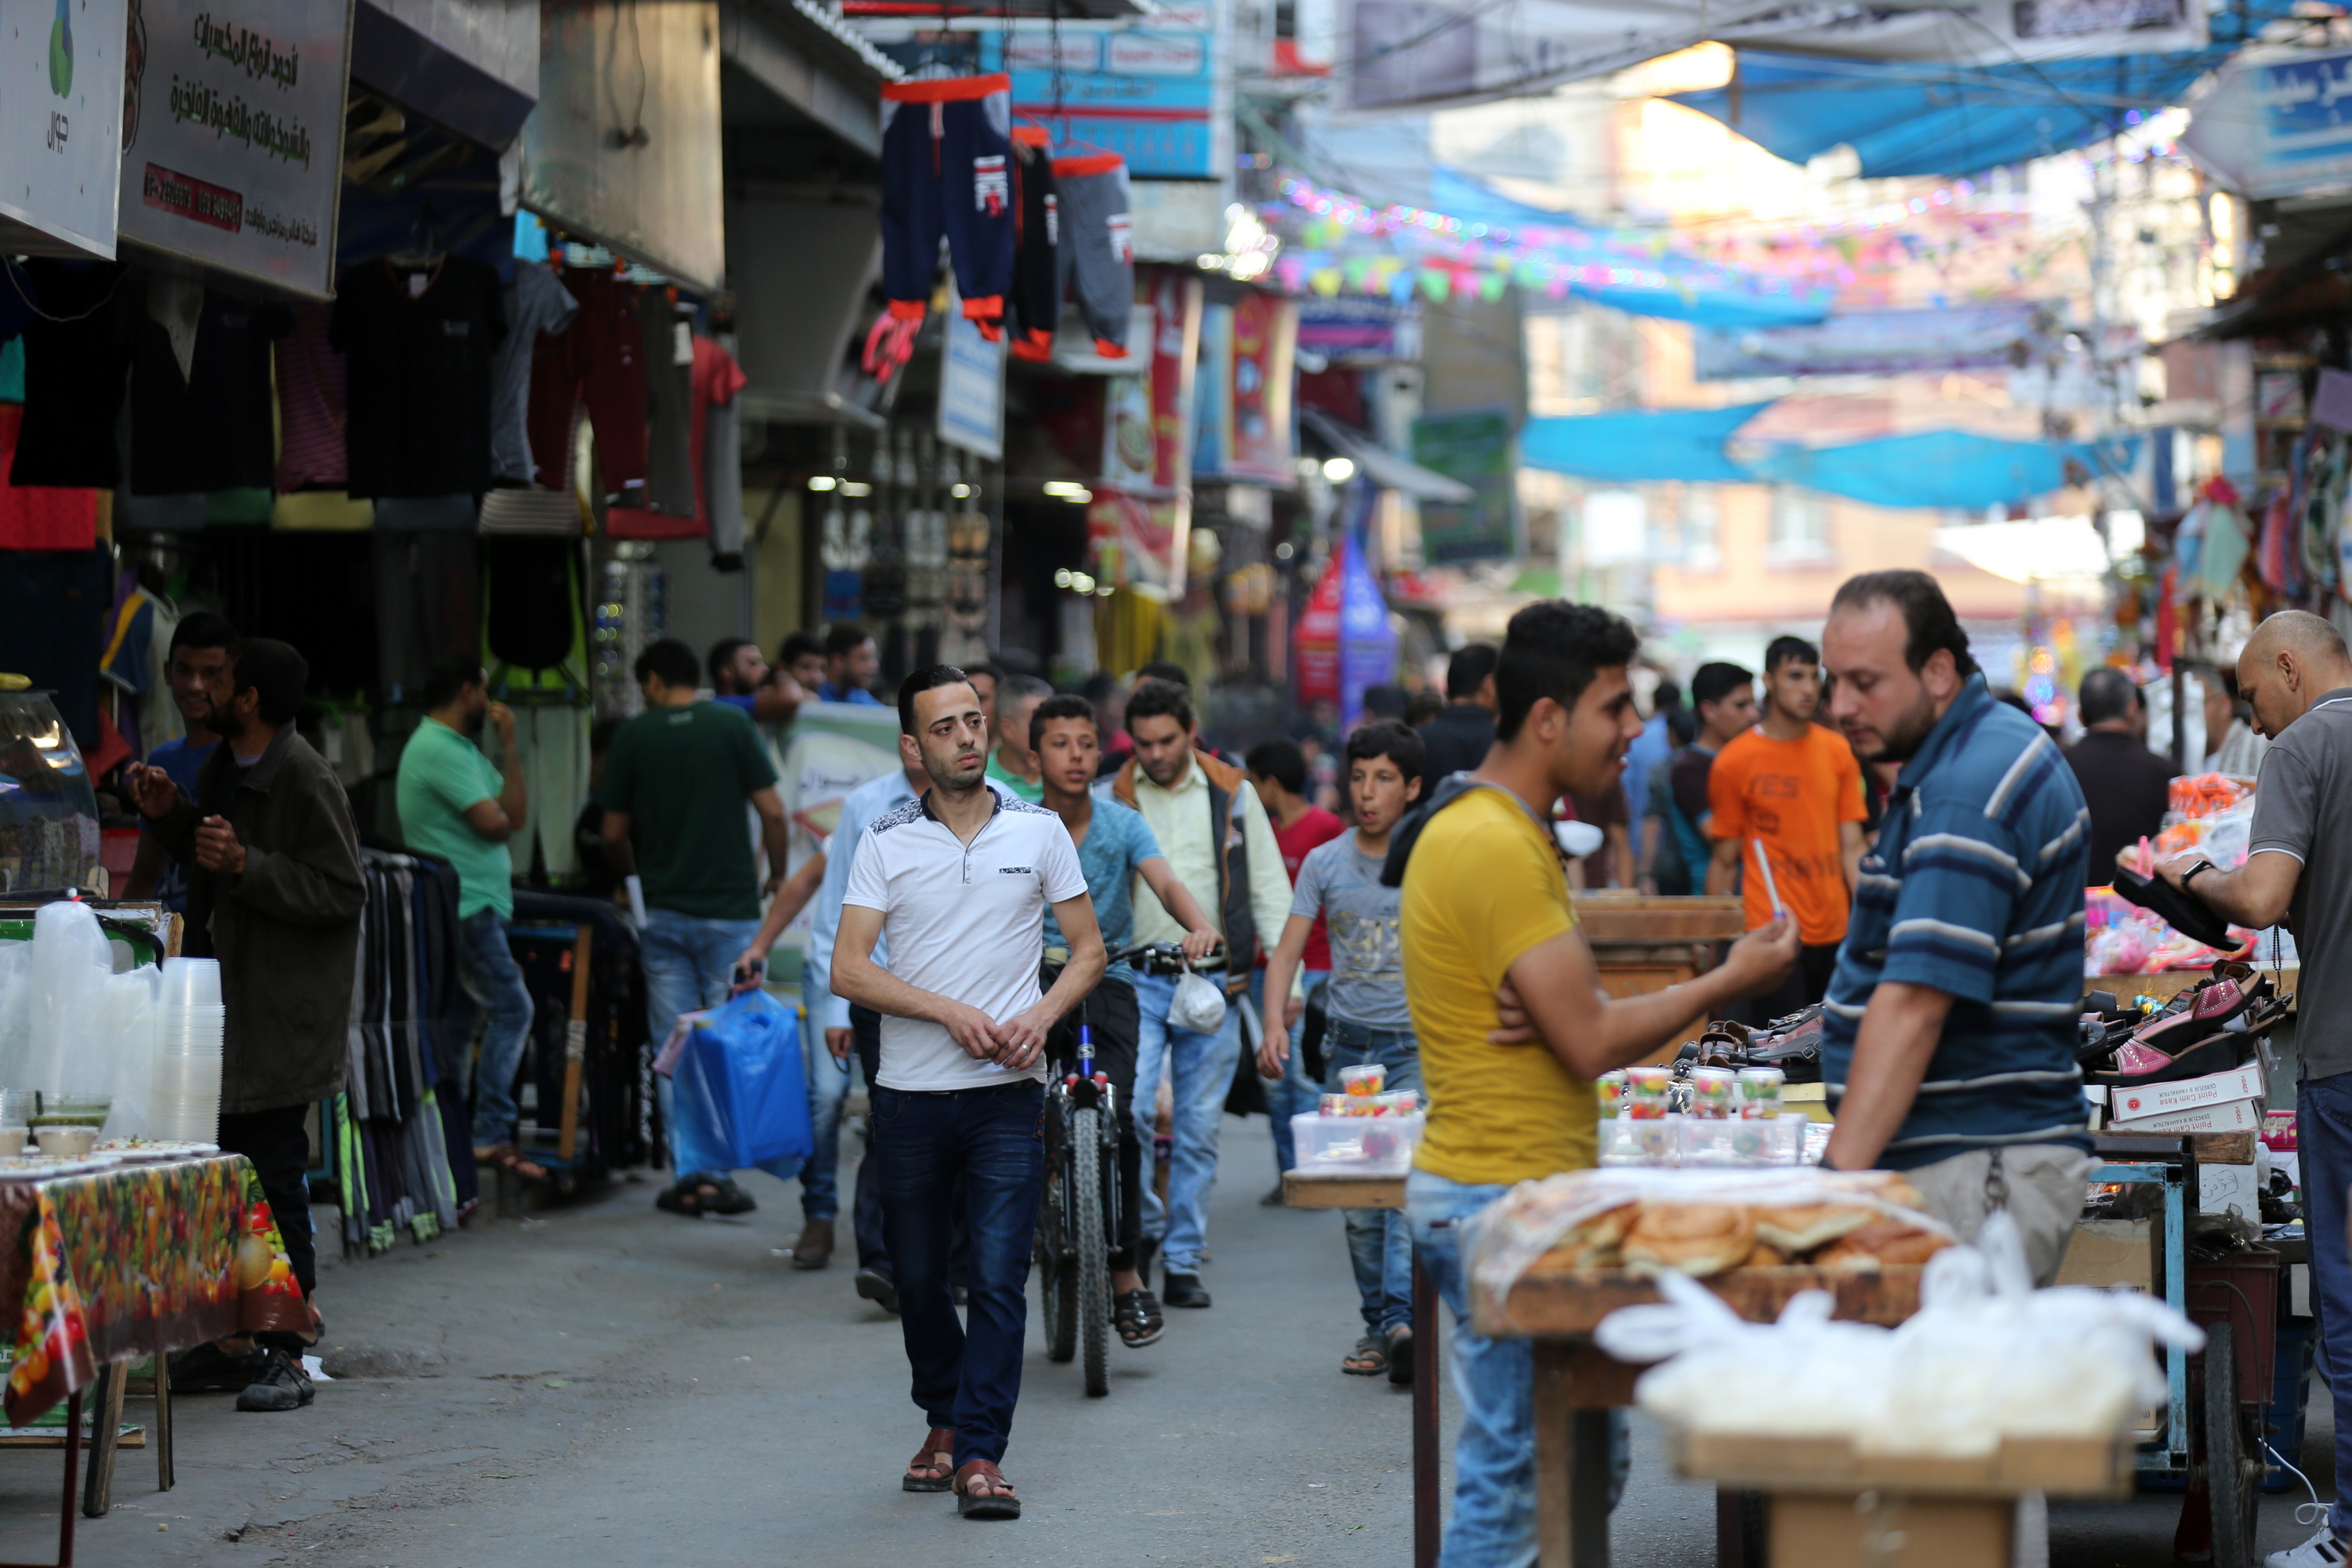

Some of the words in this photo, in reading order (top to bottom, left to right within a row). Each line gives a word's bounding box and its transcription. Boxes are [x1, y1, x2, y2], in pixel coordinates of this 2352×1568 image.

[194, 12, 248, 67] المكسرات
[170, 74, 211, 125] الفاخرة
[211, 89, 252, 149] والقهوة
[47, 110, 68, 154] جوال
[2158, 1087, 2188, 1098] KAHVALTILIK
[2180, 1093, 2198, 1102] Cam
[2198, 1090, 2218, 1100] Point
[2159, 1096, 2178, 1105] Kase
[2153, 1119, 2183, 1127] KAHVALTILIK
[2192, 1120, 2212, 1130] Point
